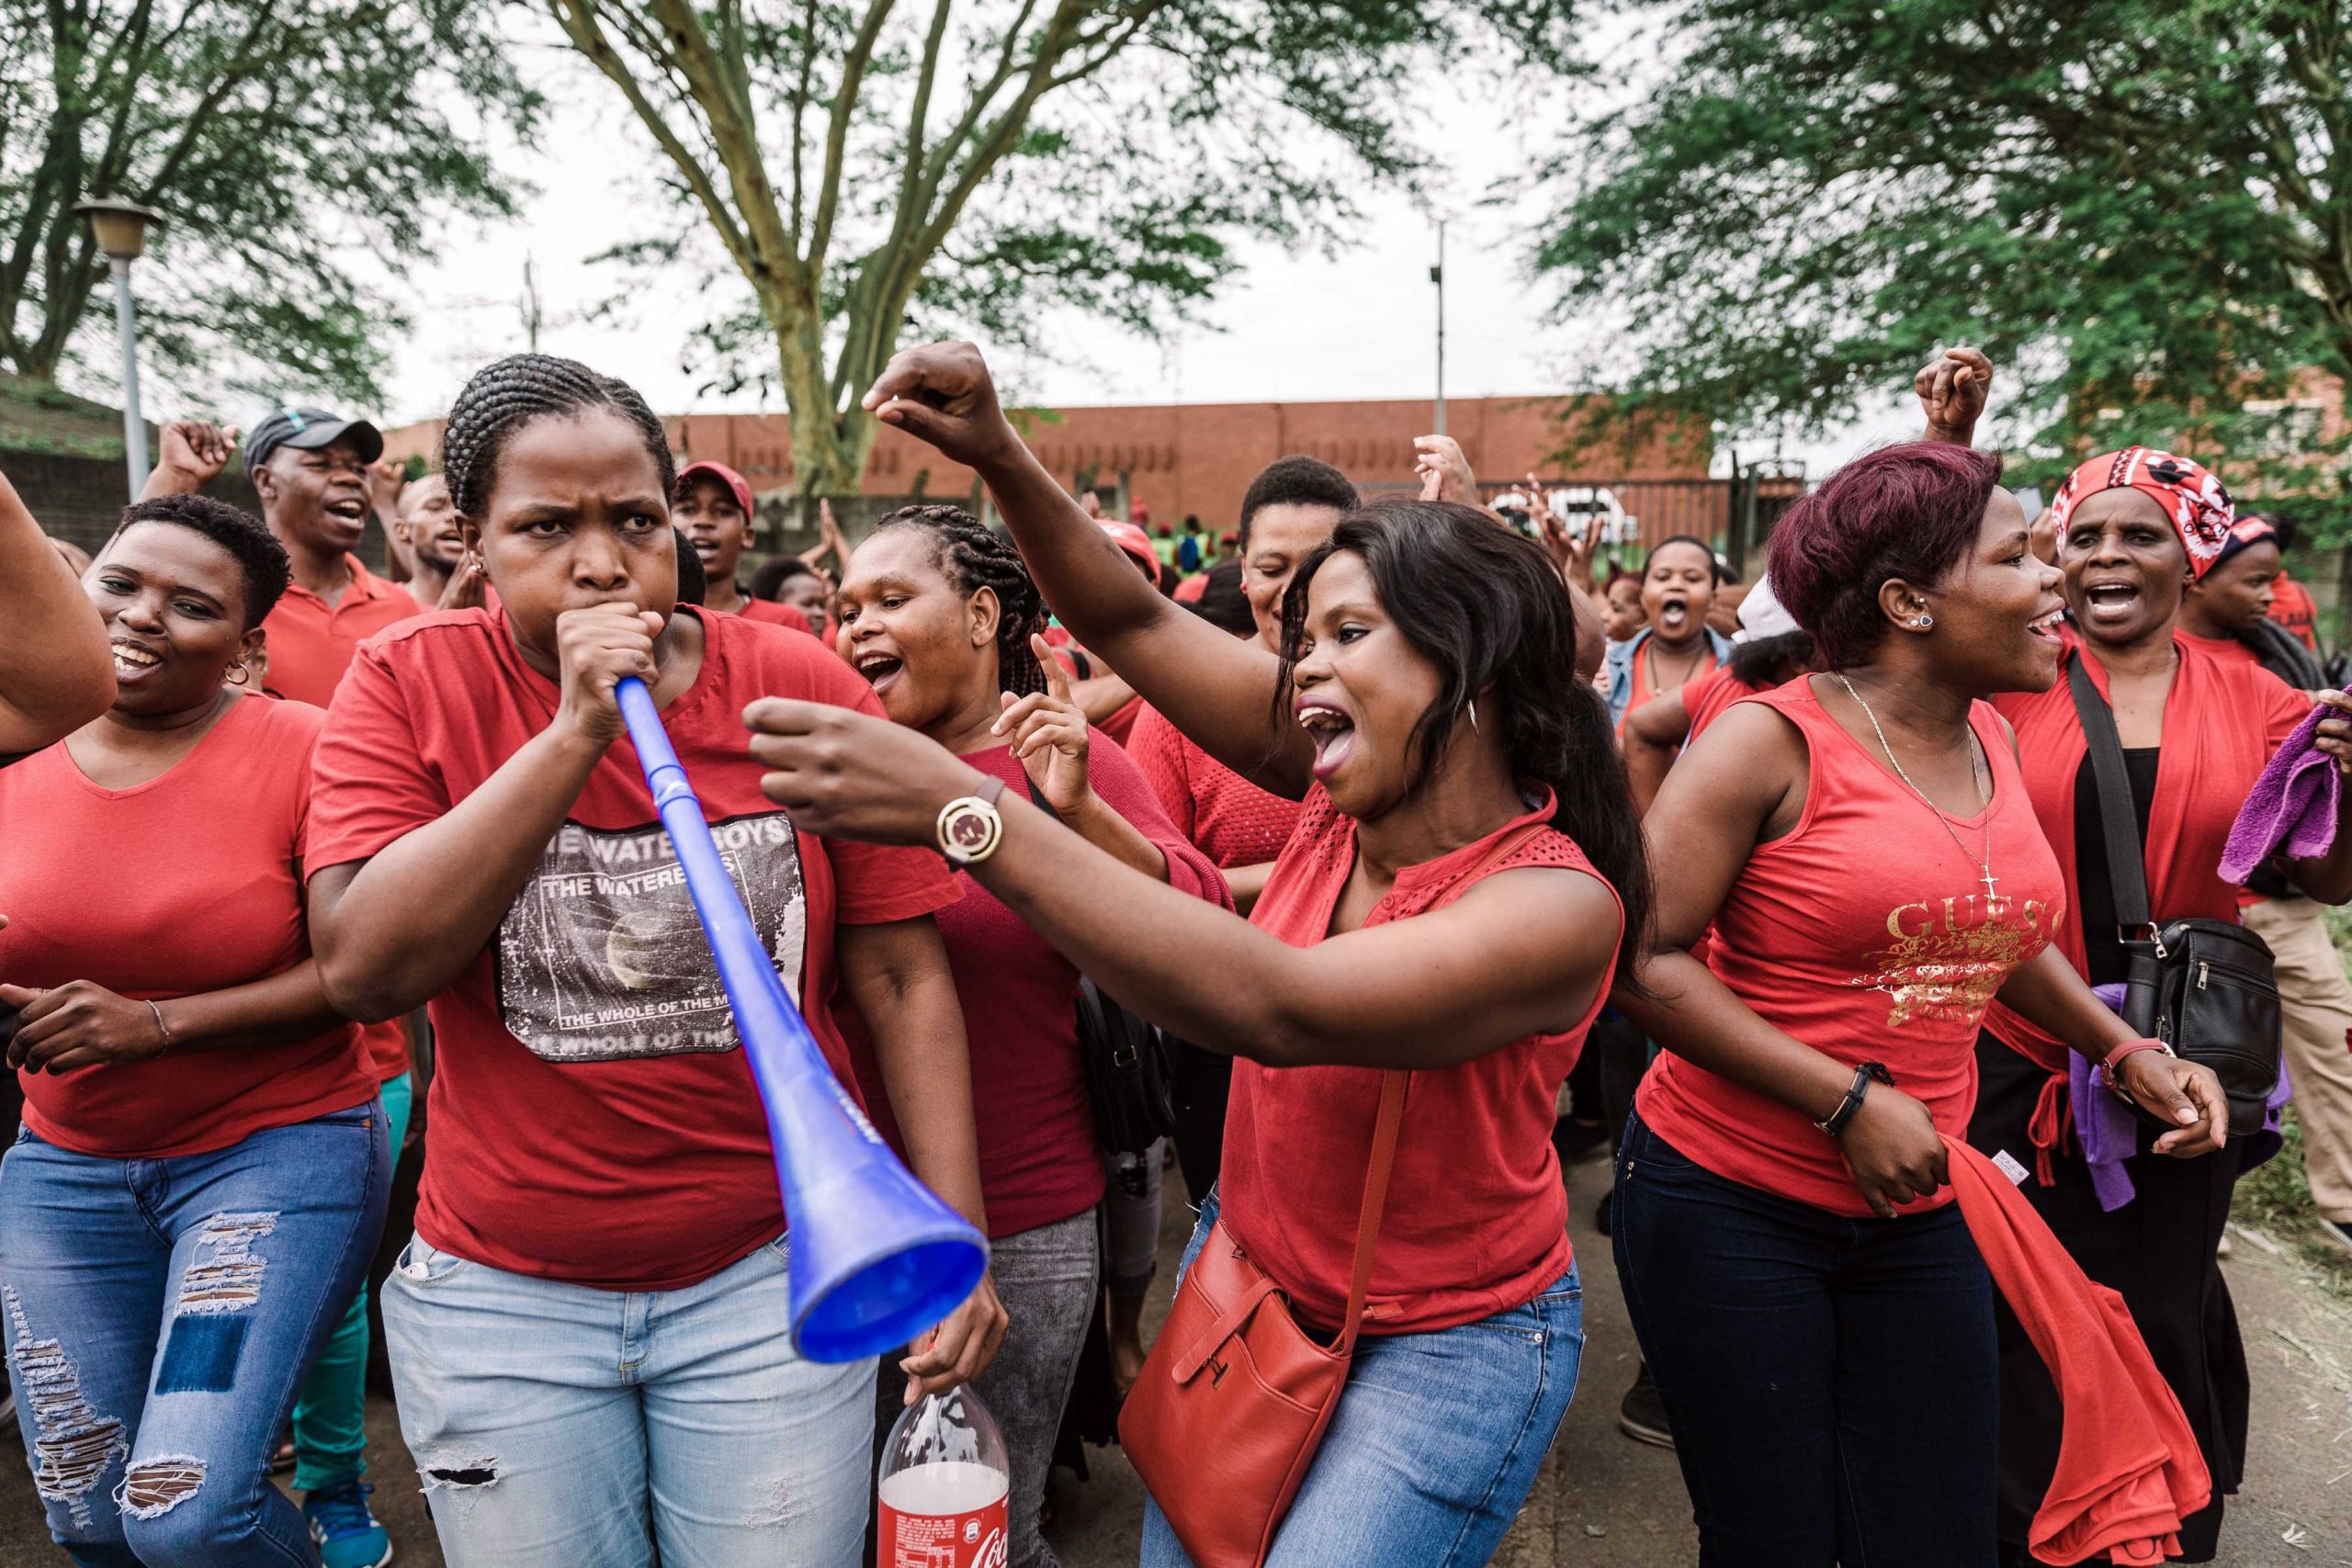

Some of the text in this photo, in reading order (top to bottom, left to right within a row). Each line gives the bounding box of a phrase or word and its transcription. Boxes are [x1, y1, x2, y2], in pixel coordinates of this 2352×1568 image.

[542, 878, 592, 898] THE
[562, 1012, 595, 1027] THE
[597, 1004, 655, 1024] WHOLE
[658, 1000, 679, 1014] OF
[681, 997, 713, 1010] THE
